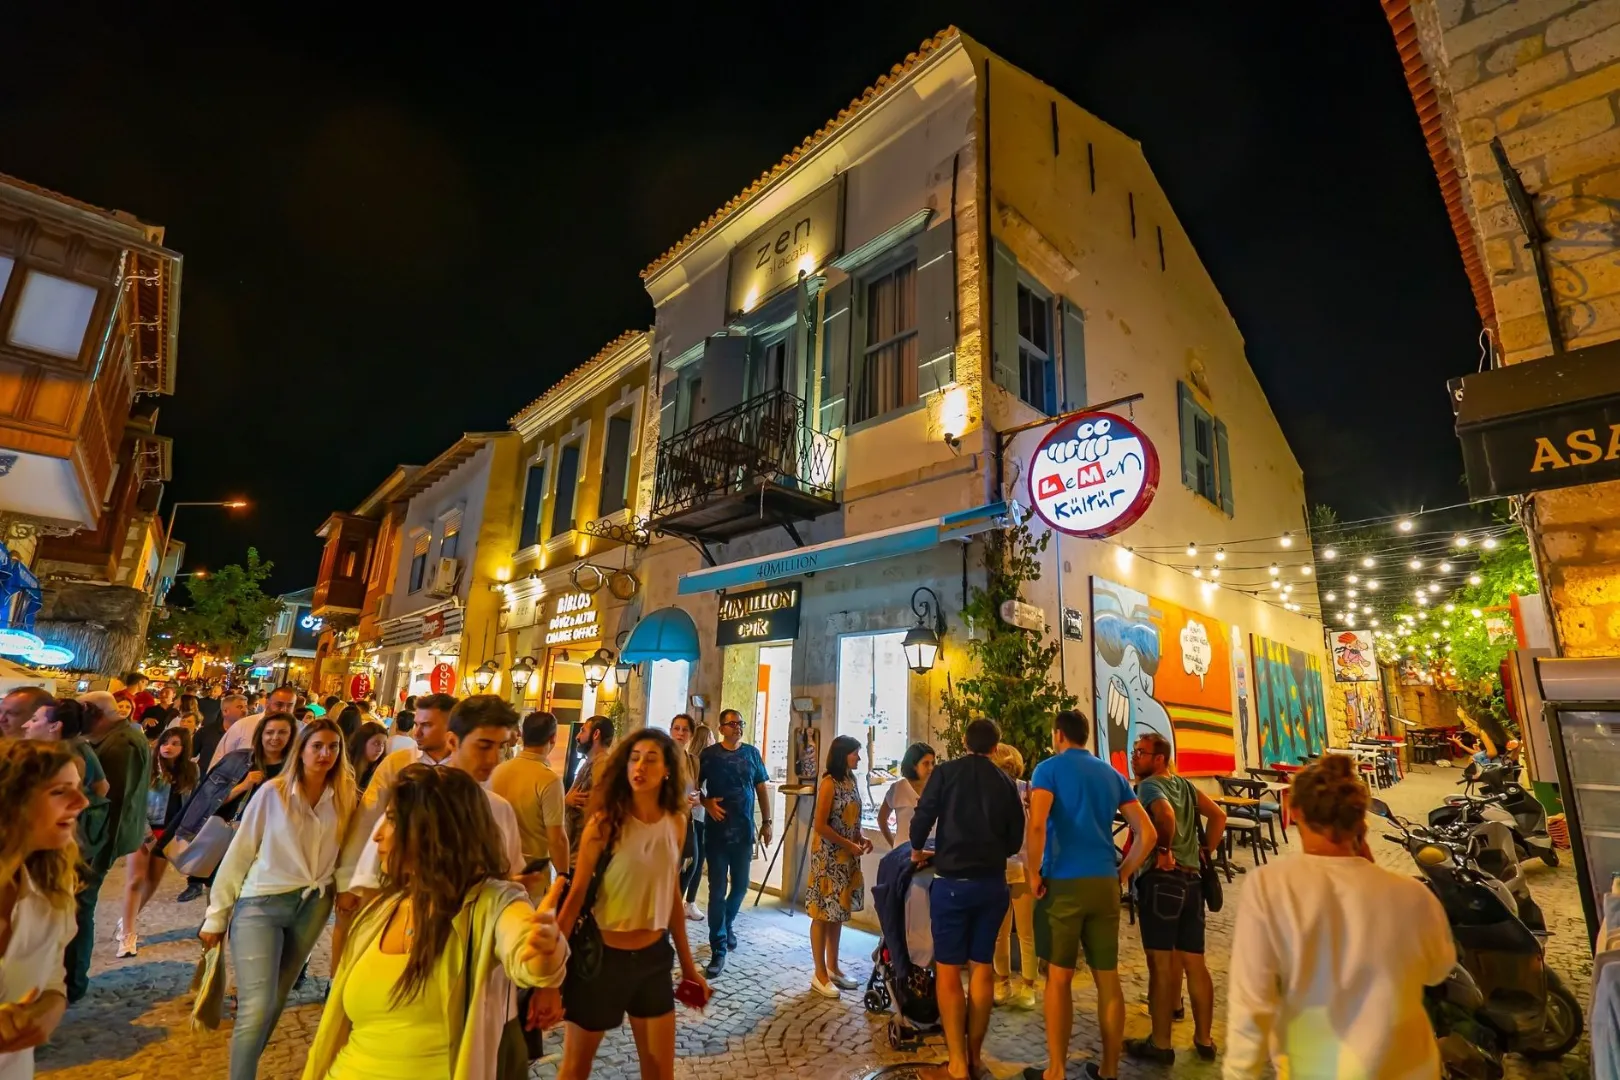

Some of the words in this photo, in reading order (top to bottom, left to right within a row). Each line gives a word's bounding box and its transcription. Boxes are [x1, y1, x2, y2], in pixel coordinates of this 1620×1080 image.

[756, 217, 811, 269] zen
[1039, 452, 1142, 500] LeMan
[1054, 488, 1125, 520] Kültür
[757, 555, 818, 577] 40MILLION
